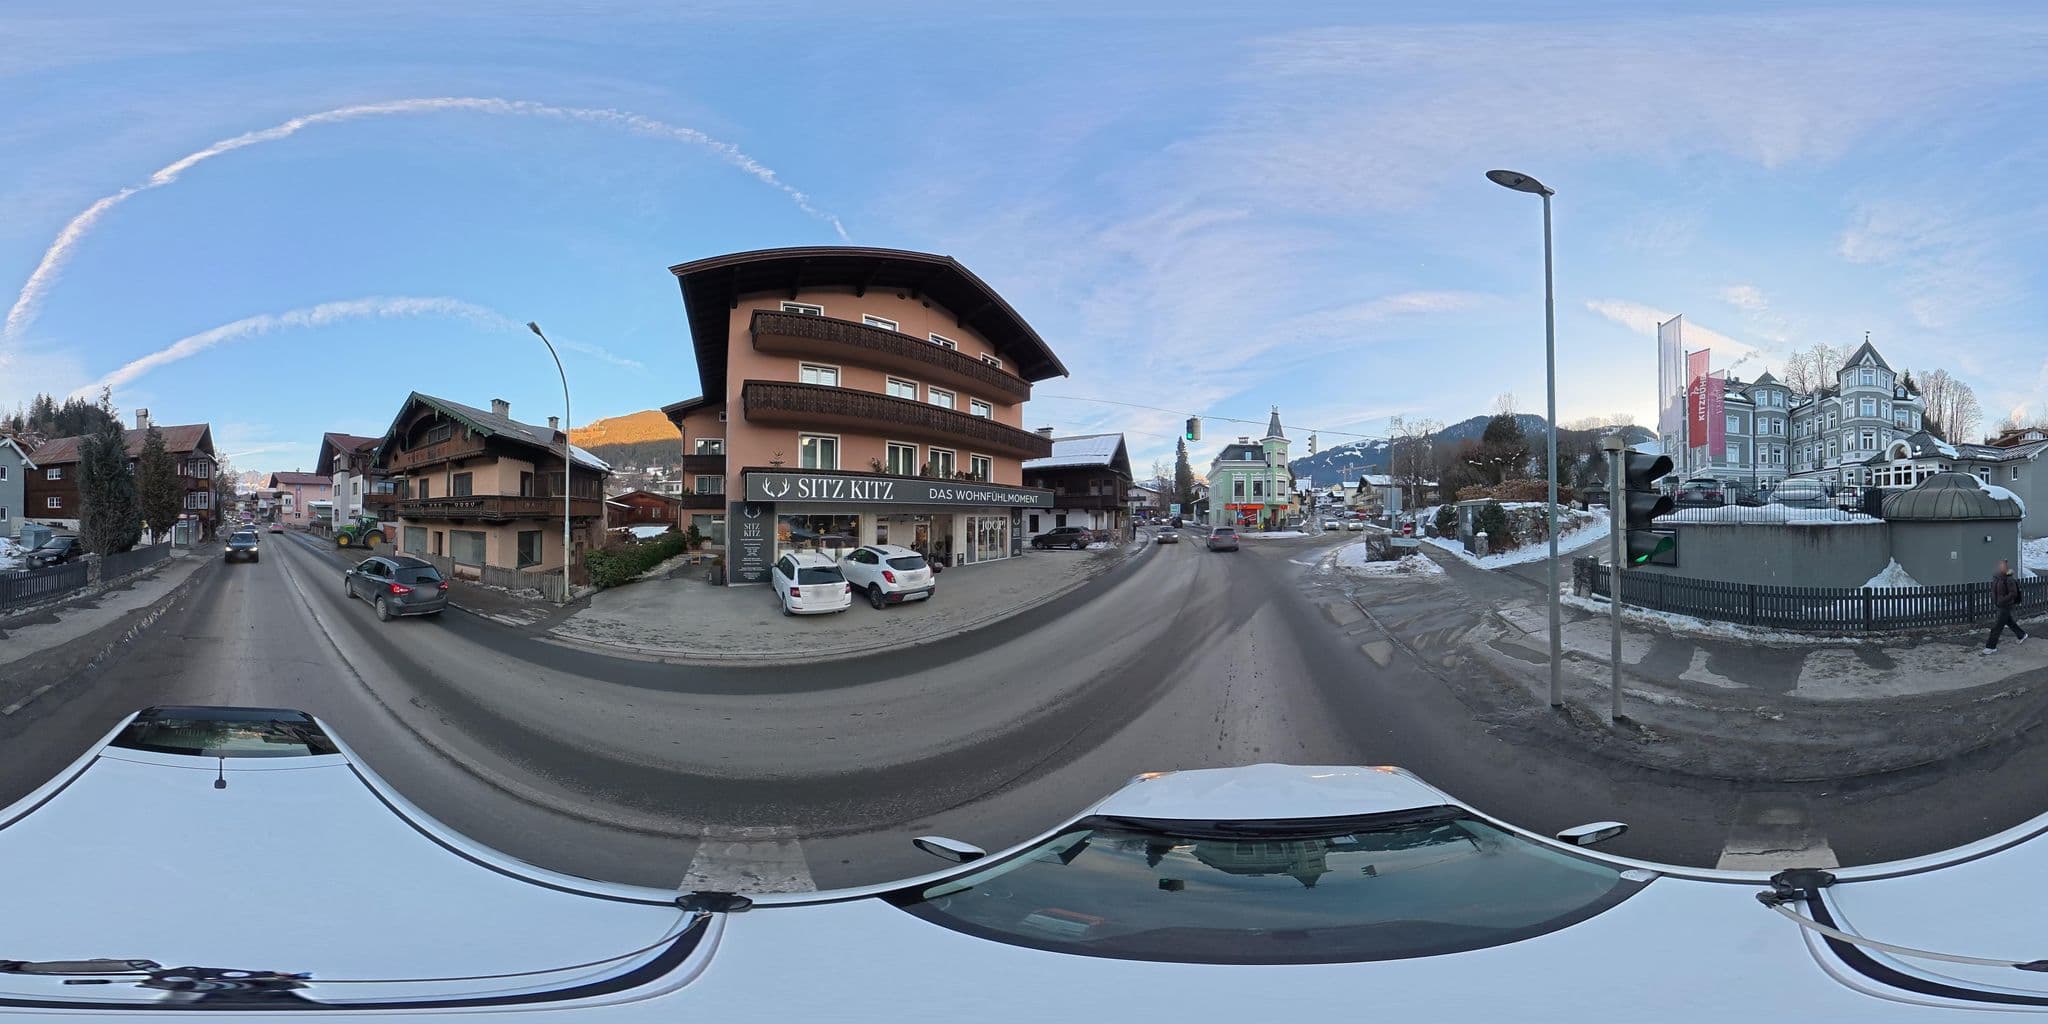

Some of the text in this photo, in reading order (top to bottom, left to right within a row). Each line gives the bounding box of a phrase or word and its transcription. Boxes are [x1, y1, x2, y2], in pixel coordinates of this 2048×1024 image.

[798, 478, 894, 500] SITZ KITZ
[929, 488, 1039, 504] DAS WOHNFÜHLMOMENT
[980, 520, 1006, 532] JOOP!
